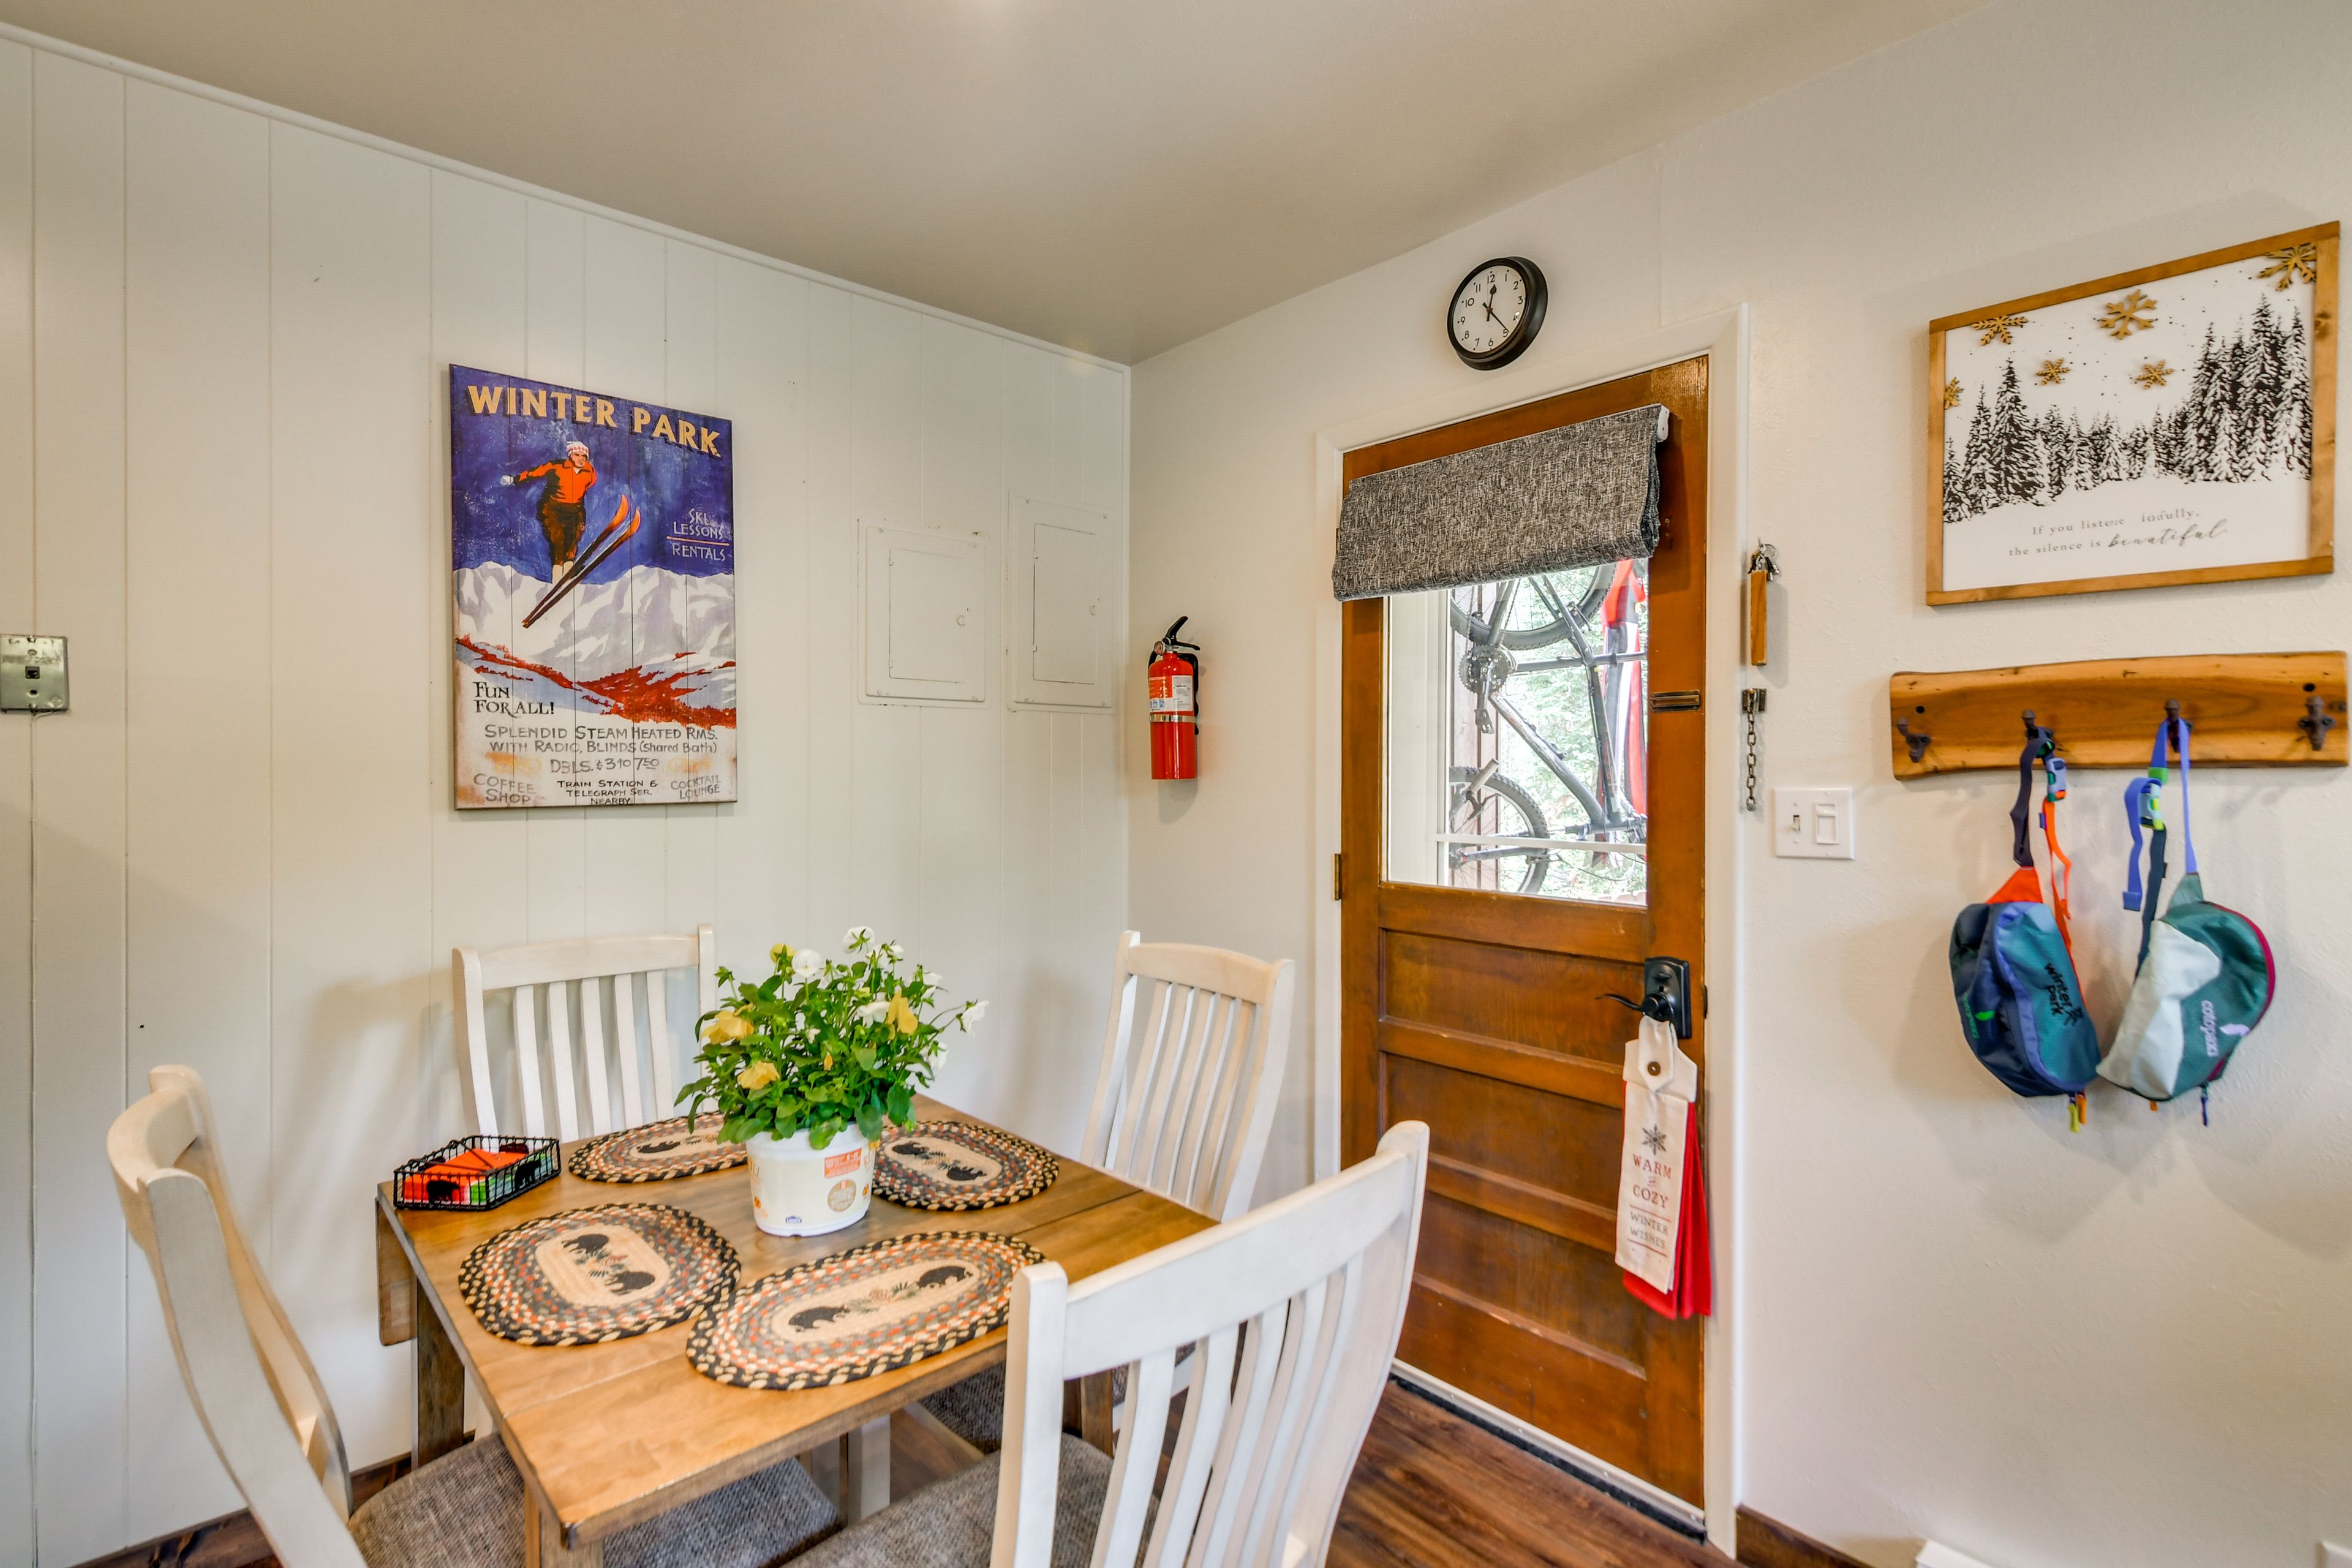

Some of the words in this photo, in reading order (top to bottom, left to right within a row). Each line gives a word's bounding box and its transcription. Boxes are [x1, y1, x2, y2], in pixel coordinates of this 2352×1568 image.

[1487, 274, 1495, 284] 12
[1513, 281, 1518, 290] 2
[1476, 284, 1481, 293] 11
[1465, 298, 1474, 307] 10
[1518, 296, 1523, 304] 3
[1460, 316, 1466, 325] 9
[1464, 330, 1469, 339] 8
[1503, 328, 1509, 337] 5
[1475, 338, 1480, 347] 7
[1488, 338, 1494, 347] 6
[467, 385, 618, 428] WINTER
[633, 407, 722, 458] PARK
[673, 521, 724, 540] LESSONS
[2032, 525, 2044, 535] If
[2049, 525, 2073, 537] you
[672, 543, 726, 562] RENTALS
[2009, 547, 2029, 556] the
[2035, 543, 2082, 554] silence
[513, 701, 554, 715] ALL!
[484, 724, 568, 739] SPLENDID
[575, 726, 628, 739] STEAM
[631, 727, 682, 739] HEATED
[490, 742, 527, 753] WITH
[587, 741, 636, 753] BLINDS
[683, 742, 717, 753] Bath)
[473, 774, 537, 794] COFFEE
[671, 775, 722, 790] COCKTAIL
[485, 788, 531, 805] SHOP
[679, 784, 722, 800] LOUNGE
[2045, 963, 2073, 1008] winter
[2199, 1000, 2219, 1057] cotopaxi
[1632, 1154, 1671, 1179] WARM
[1633, 1185, 1669, 1208] COZY
[1630, 1211, 1669, 1235] WINTER
[1630, 1226, 1666, 1248] WISHES
